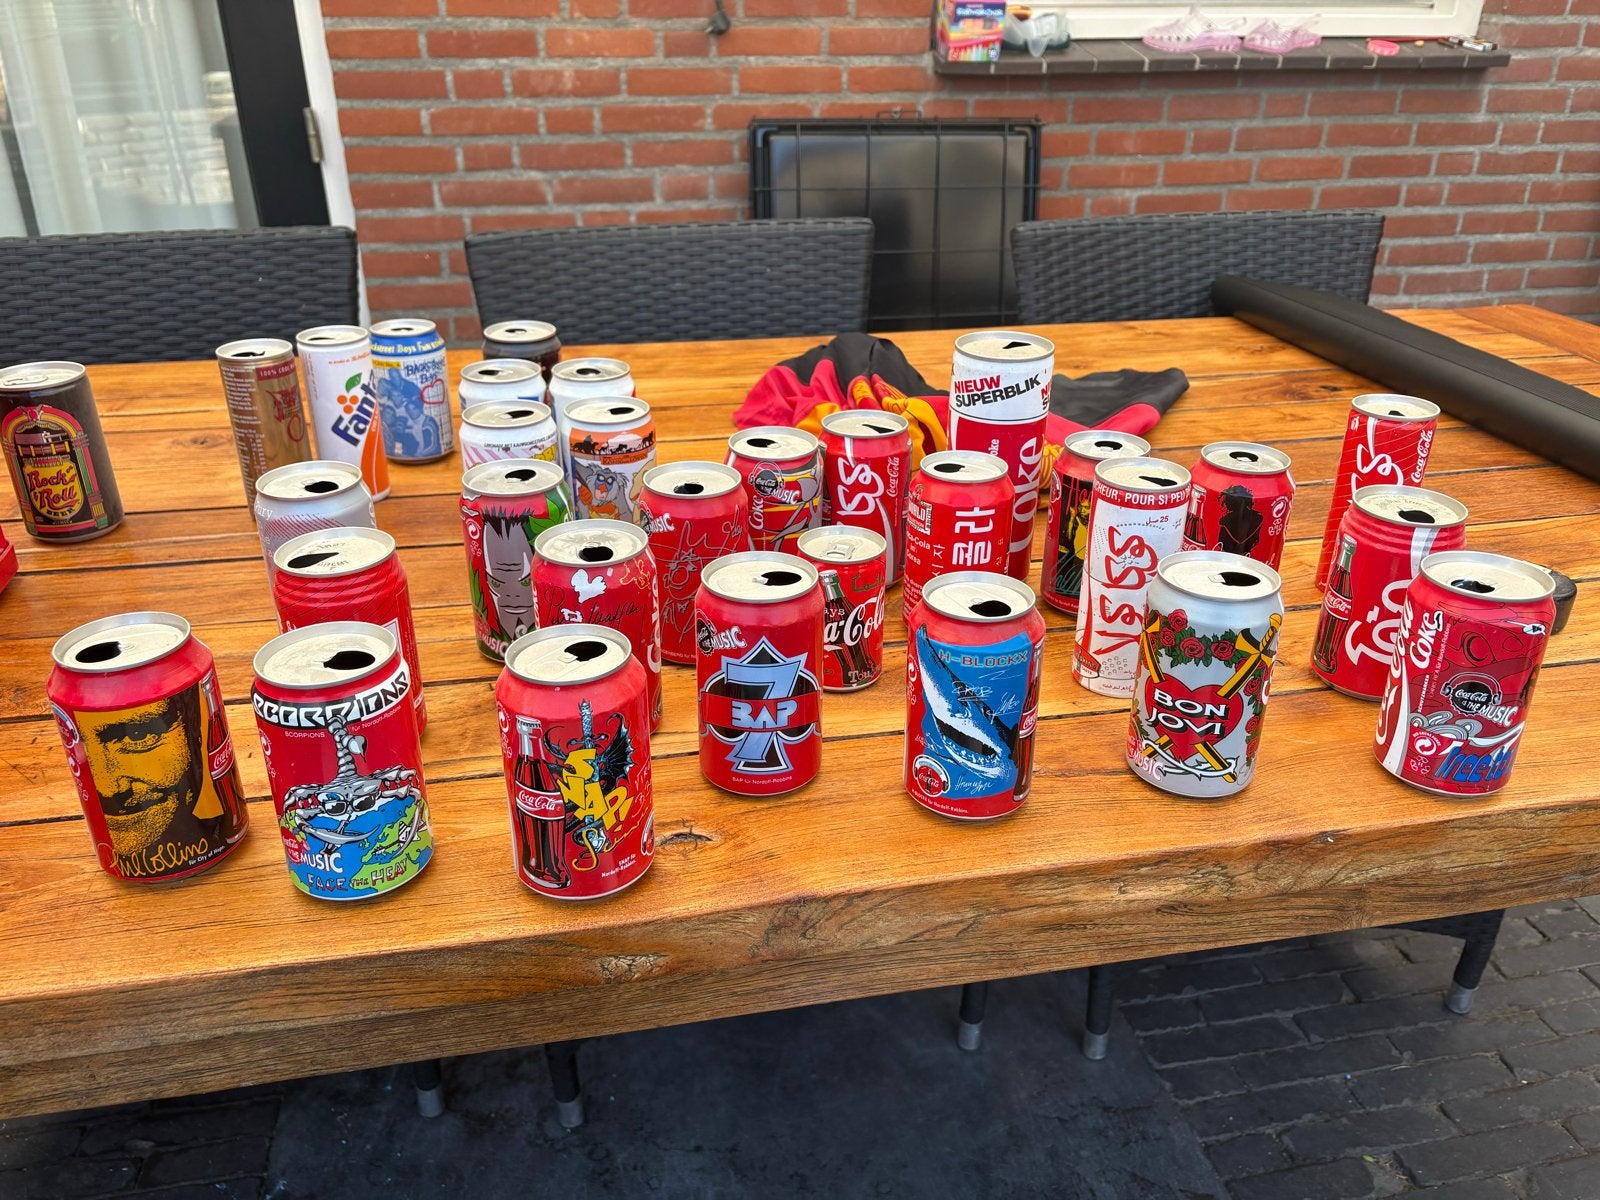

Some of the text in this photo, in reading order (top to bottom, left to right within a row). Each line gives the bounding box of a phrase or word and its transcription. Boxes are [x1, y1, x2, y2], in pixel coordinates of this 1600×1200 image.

[954, 375, 1001, 394] NIEUW
[955, 373, 1041, 408] SUPERBLIK
[331, 383, 377, 447] Fant
[987, 439, 1000, 457] oke
[886, 456, 900, 498] Coca-Cola
[771, 489, 800, 505] MUSIC
[1124, 492, 1155, 505] POUR
[1158, 494, 1168, 505] SI
[650, 512, 675, 533] MUSIC
[952, 507, 995, 567] 콜라
[824, 606, 845, 617] ays
[711, 626, 747, 649] MUSIC
[938, 649, 1029, 668] H-BLOCKX
[1153, 687, 1229, 720] BON
[1455, 689, 1488, 702] Coca-Cola
[731, 700, 798, 729] BAP
[1146, 707, 1224, 738] JOVI
[1467, 701, 1480, 711] THE
[1478, 705, 1519, 728] MUSIC
[285, 731, 325, 739] SCORPIONS
[518, 790, 556, 811] Coca-Cola
[197, 852, 208, 866] City
[299, 851, 344, 874] MUSIC
[307, 873, 348, 892] FACE
